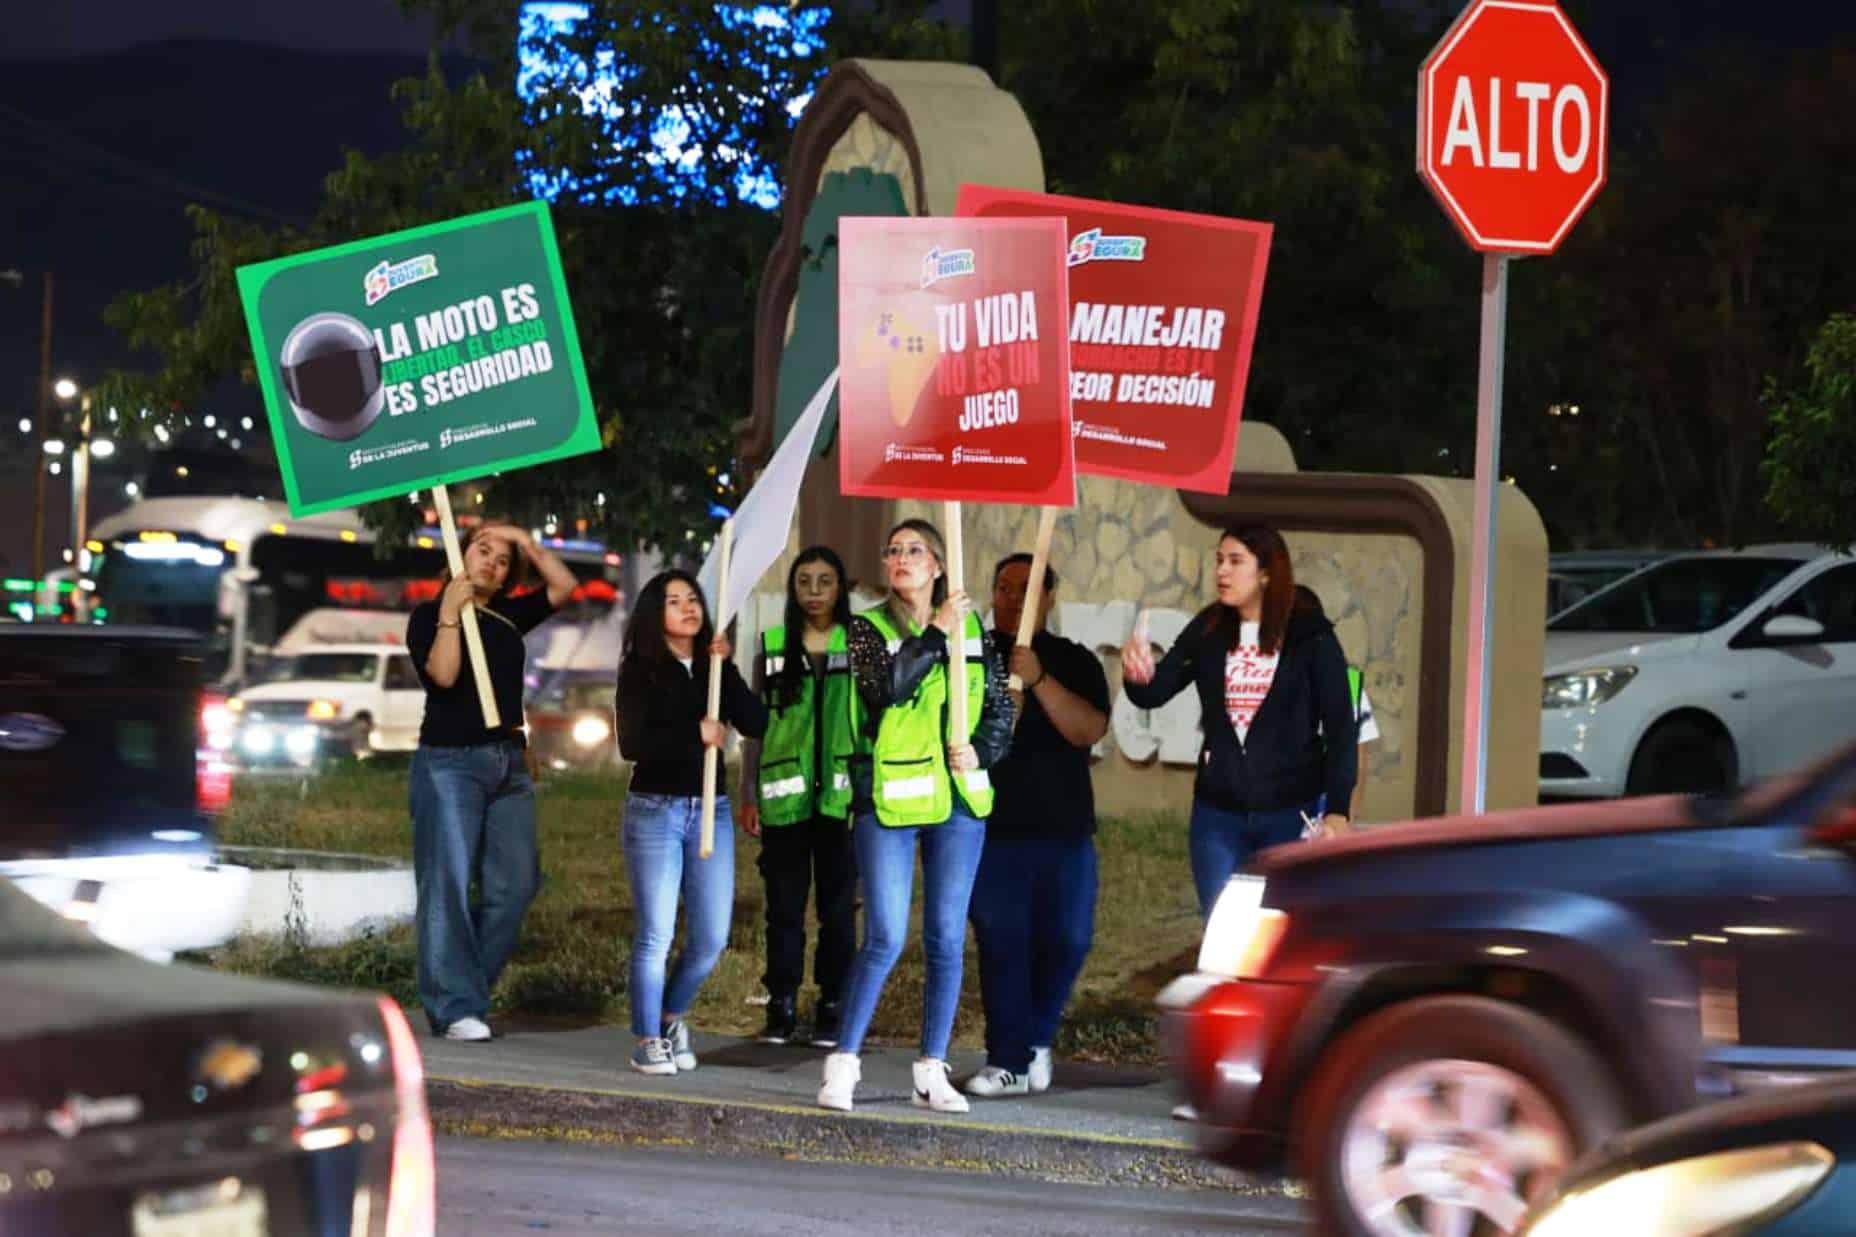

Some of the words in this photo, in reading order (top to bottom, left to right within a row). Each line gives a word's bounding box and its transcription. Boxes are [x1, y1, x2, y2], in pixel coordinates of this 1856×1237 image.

[1440, 75, 1592, 175] ALTO
[373, 322, 413, 362] LA
[415, 295, 498, 353] MOTO
[501, 283, 540, 325] ES
[467, 336, 488, 358] EL
[491, 319, 547, 350] CASCO
[935, 303, 967, 353] TU
[974, 290, 1039, 348] VIDA
[1070, 302, 1225, 351] MANEJAR
[385, 382, 418, 416] ES
[421, 340, 553, 407] SEGURIDAD
[937, 354, 967, 396] NO
[975, 346, 1002, 391] ES
[1008, 341, 1040, 386] UN
[1070, 370, 1114, 402] EOR
[1116, 371, 1216, 409] DECISIÓN
[959, 388, 1019, 432] JUEGO
